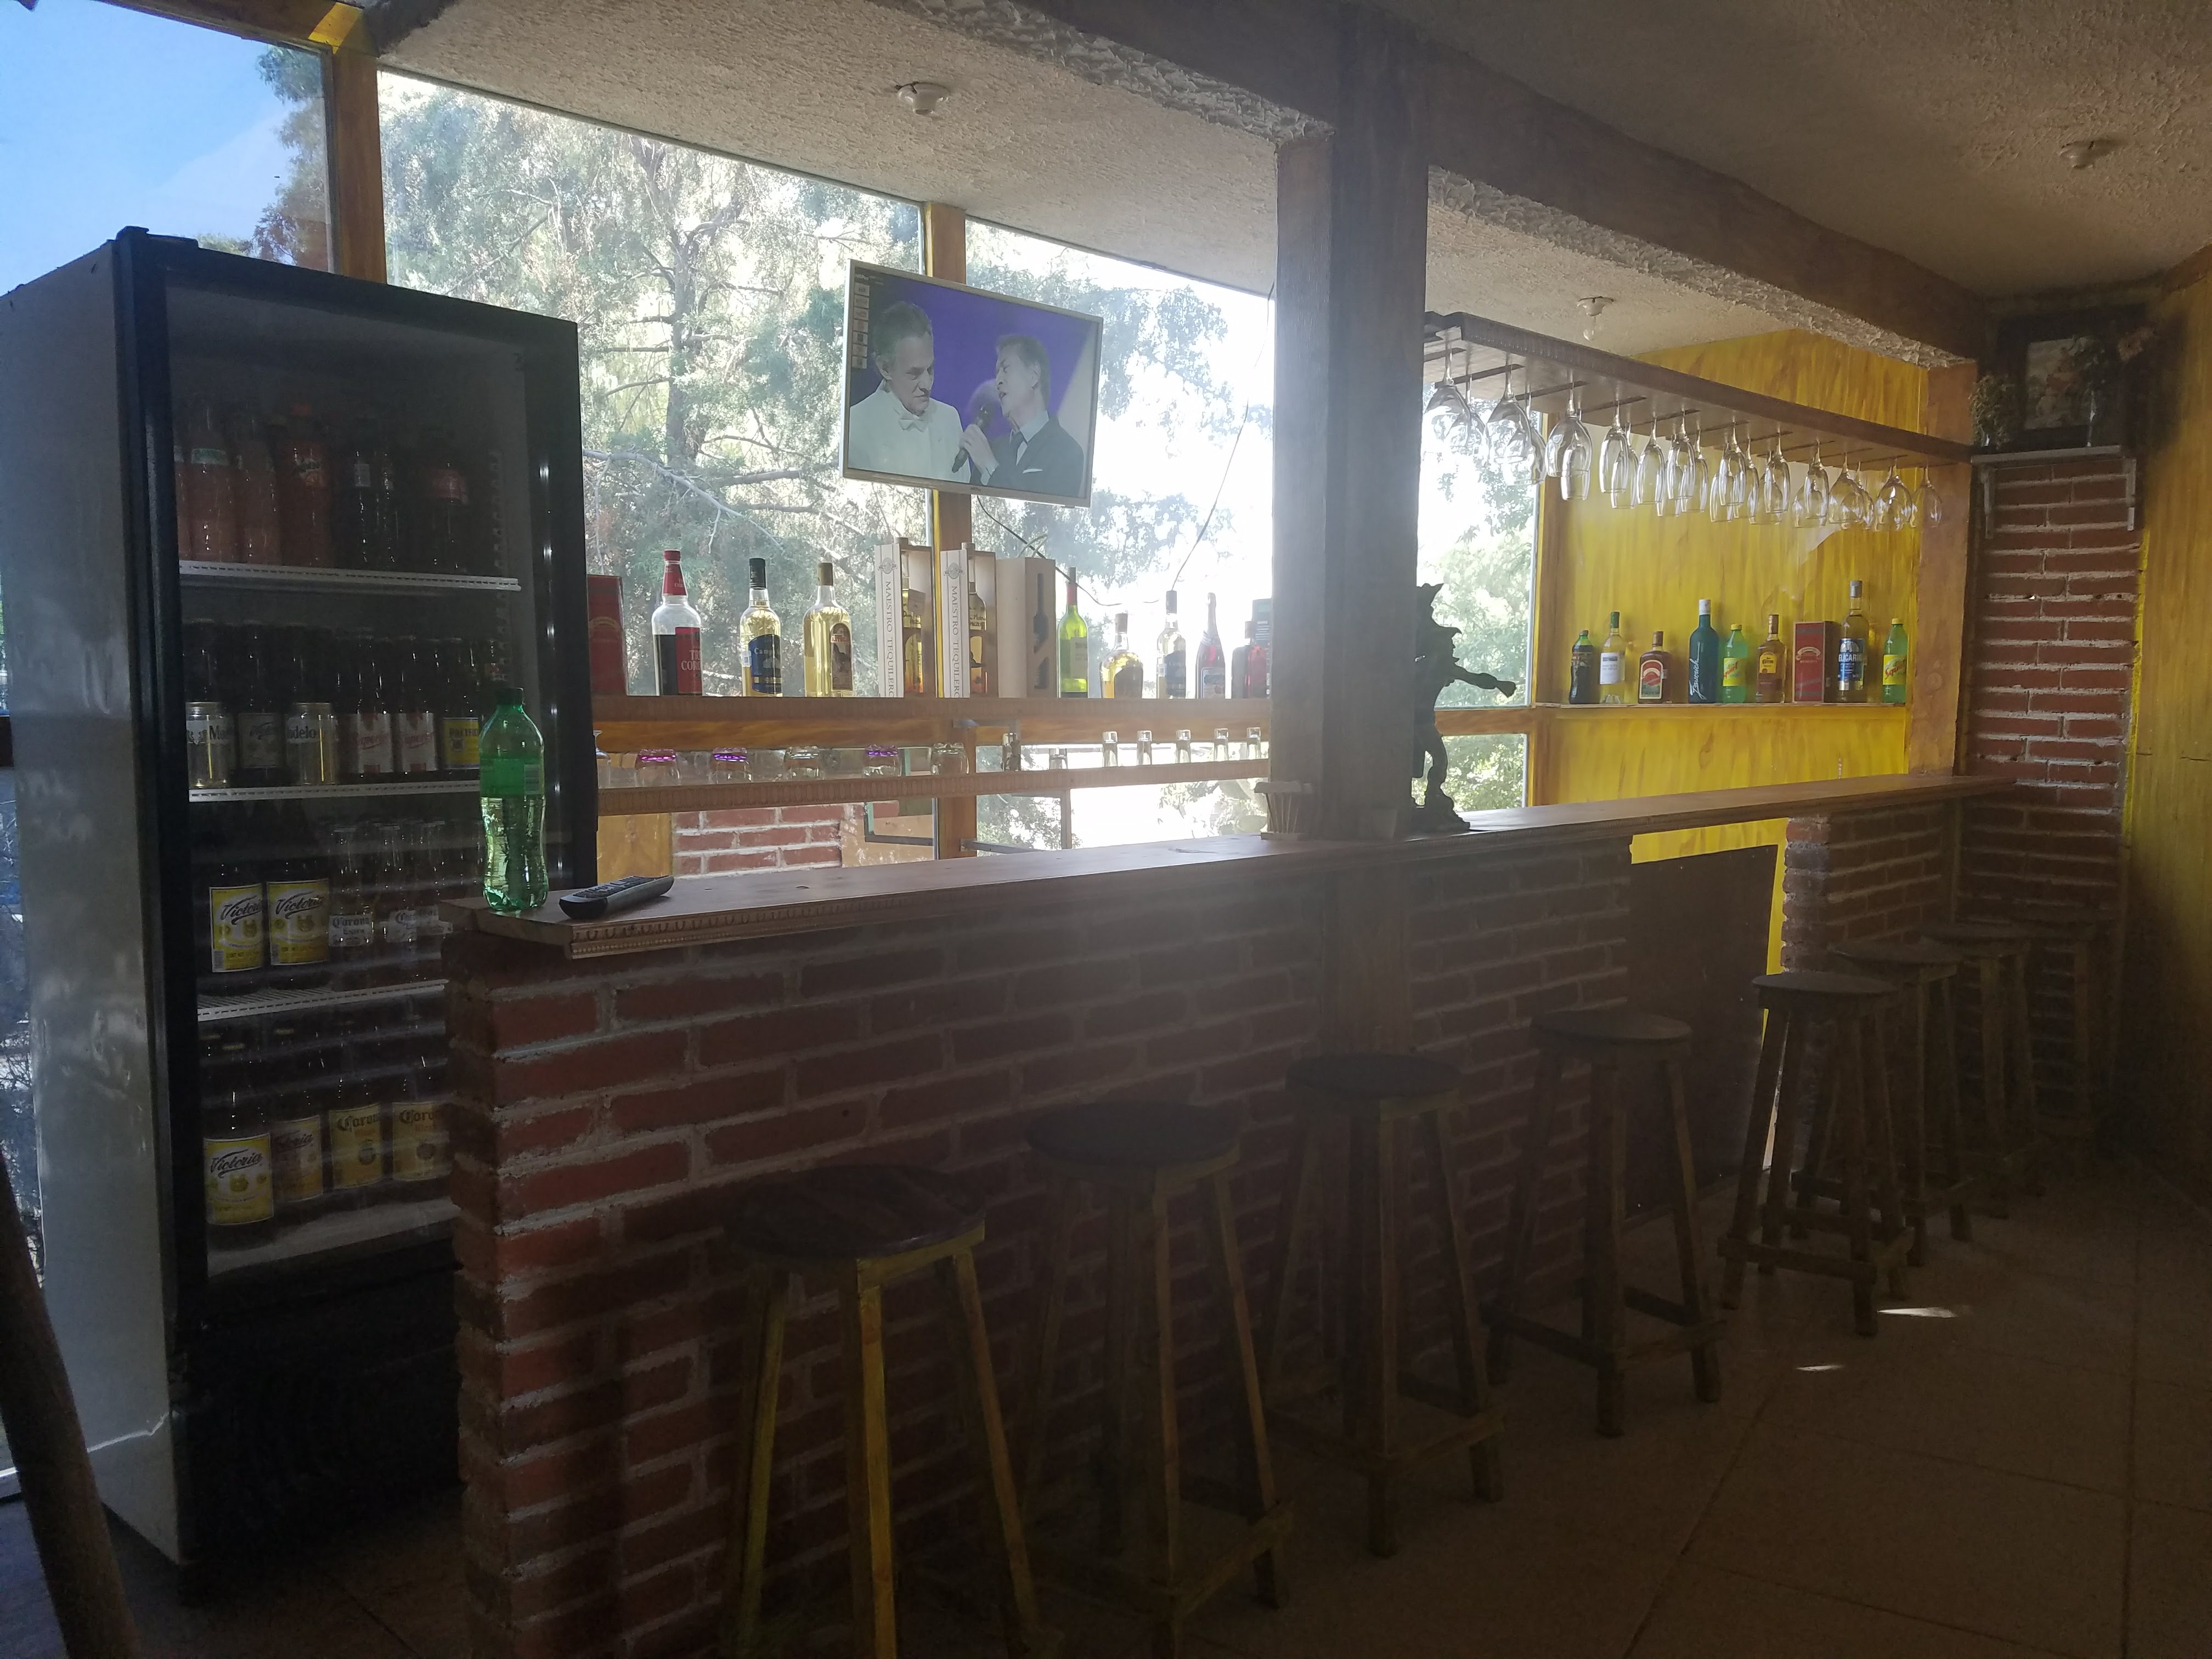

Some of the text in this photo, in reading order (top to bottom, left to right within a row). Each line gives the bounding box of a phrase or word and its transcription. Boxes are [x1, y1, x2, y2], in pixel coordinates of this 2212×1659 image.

[885, 581, 893, 632] MAESTRO
[951, 585, 960, 636] MAESTRO
[754, 647, 774, 656] Camp
[275, 890, 324, 919] Victoria
[332, 917, 369, 928] Corona
[210, 1148, 263, 1179] Victoria
